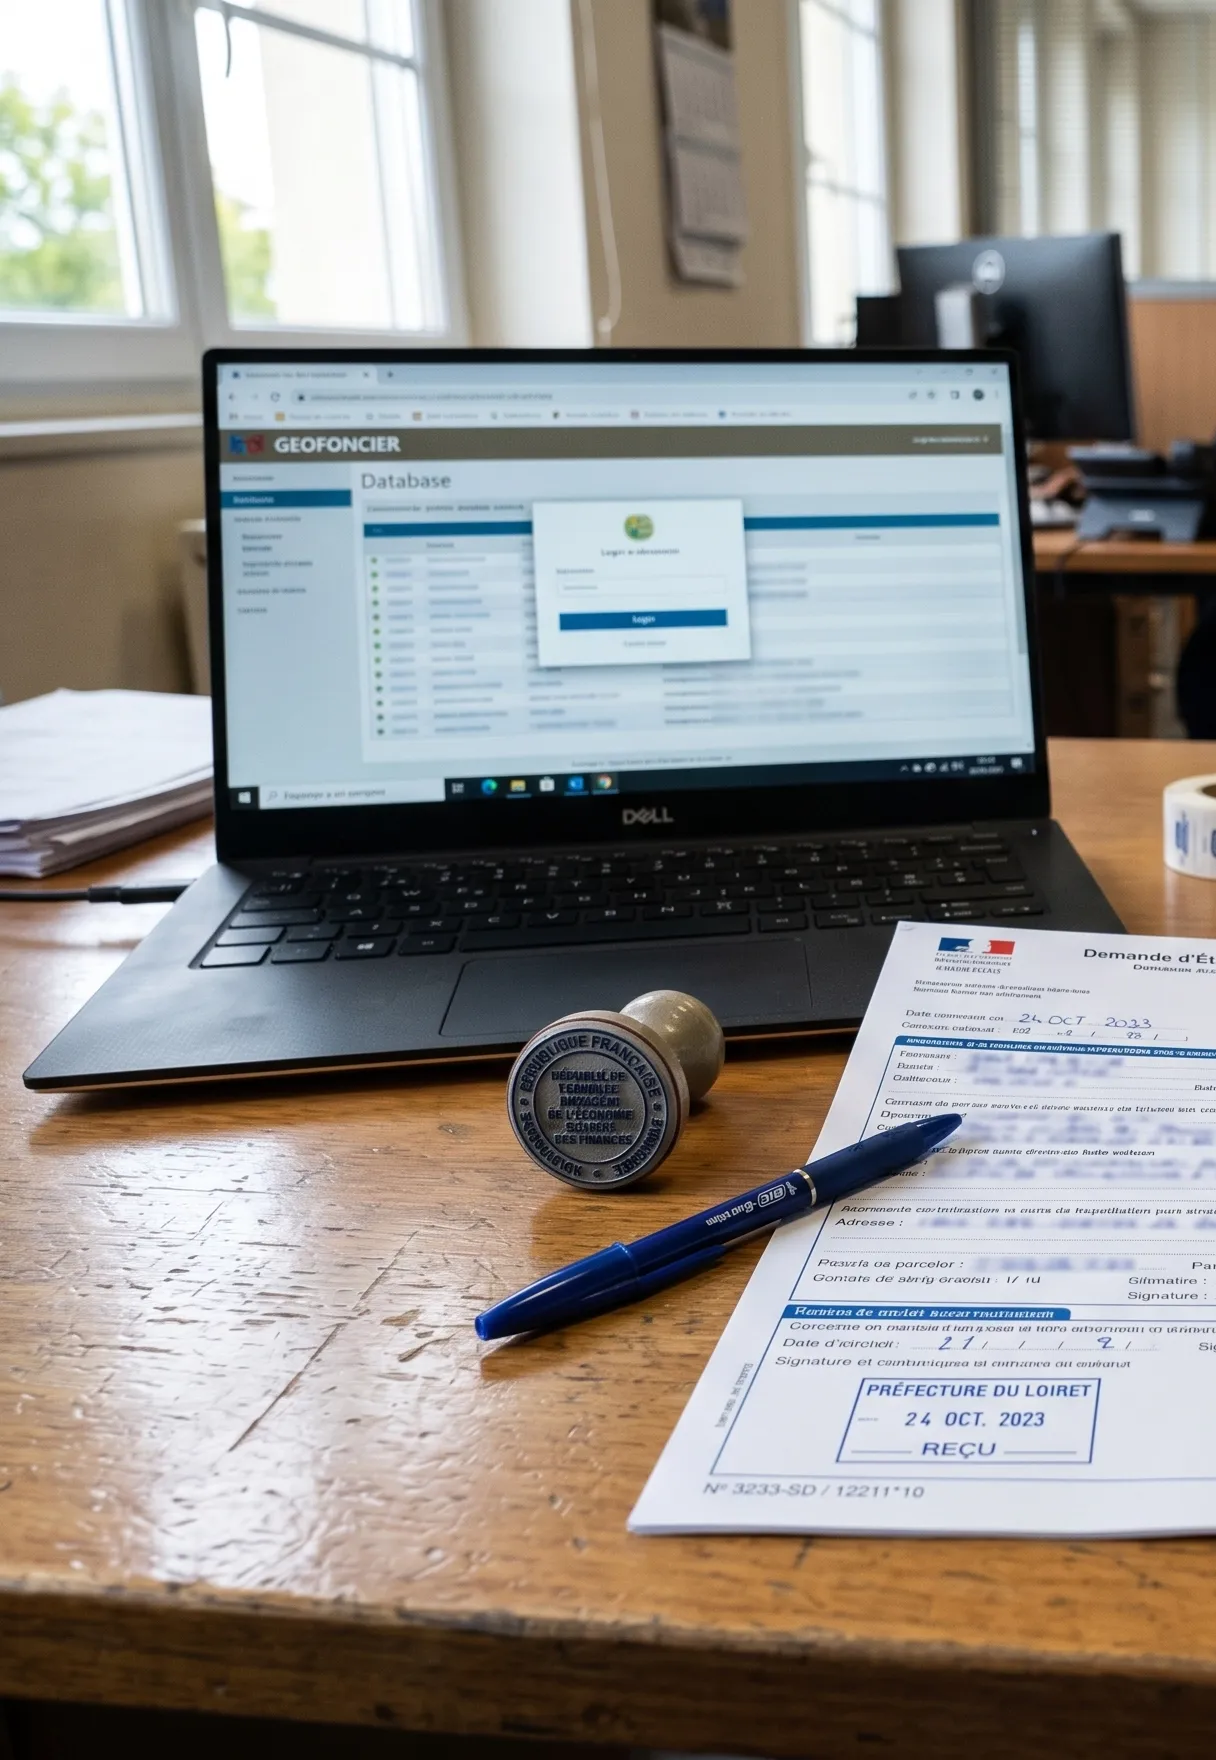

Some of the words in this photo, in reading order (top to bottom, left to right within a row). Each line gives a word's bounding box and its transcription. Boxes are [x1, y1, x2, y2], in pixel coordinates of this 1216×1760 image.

[274, 436, 401, 454] GEOFONCIER
[361, 472, 452, 490] Database
[623, 808, 674, 825] DELL
[1083, 949, 1172, 963] Demande
[835, 1218, 895, 1227] Adresse
[1127, 1291, 1199, 1302] Signature
[782, 1338, 820, 1348] Date
[775, 1356, 852, 1367] Signature
[993, 1384, 1020, 1398] DU
[1025, 1384, 1092, 1398] LOIRET
[904, 1411, 932, 1427] 24
[944, 1411, 987, 1428] OCT.
[999, 1411, 1045, 1428] 2023
[921, 1442, 997, 1459] REÇU
[731, 1483, 817, 1497] 3233-SD
